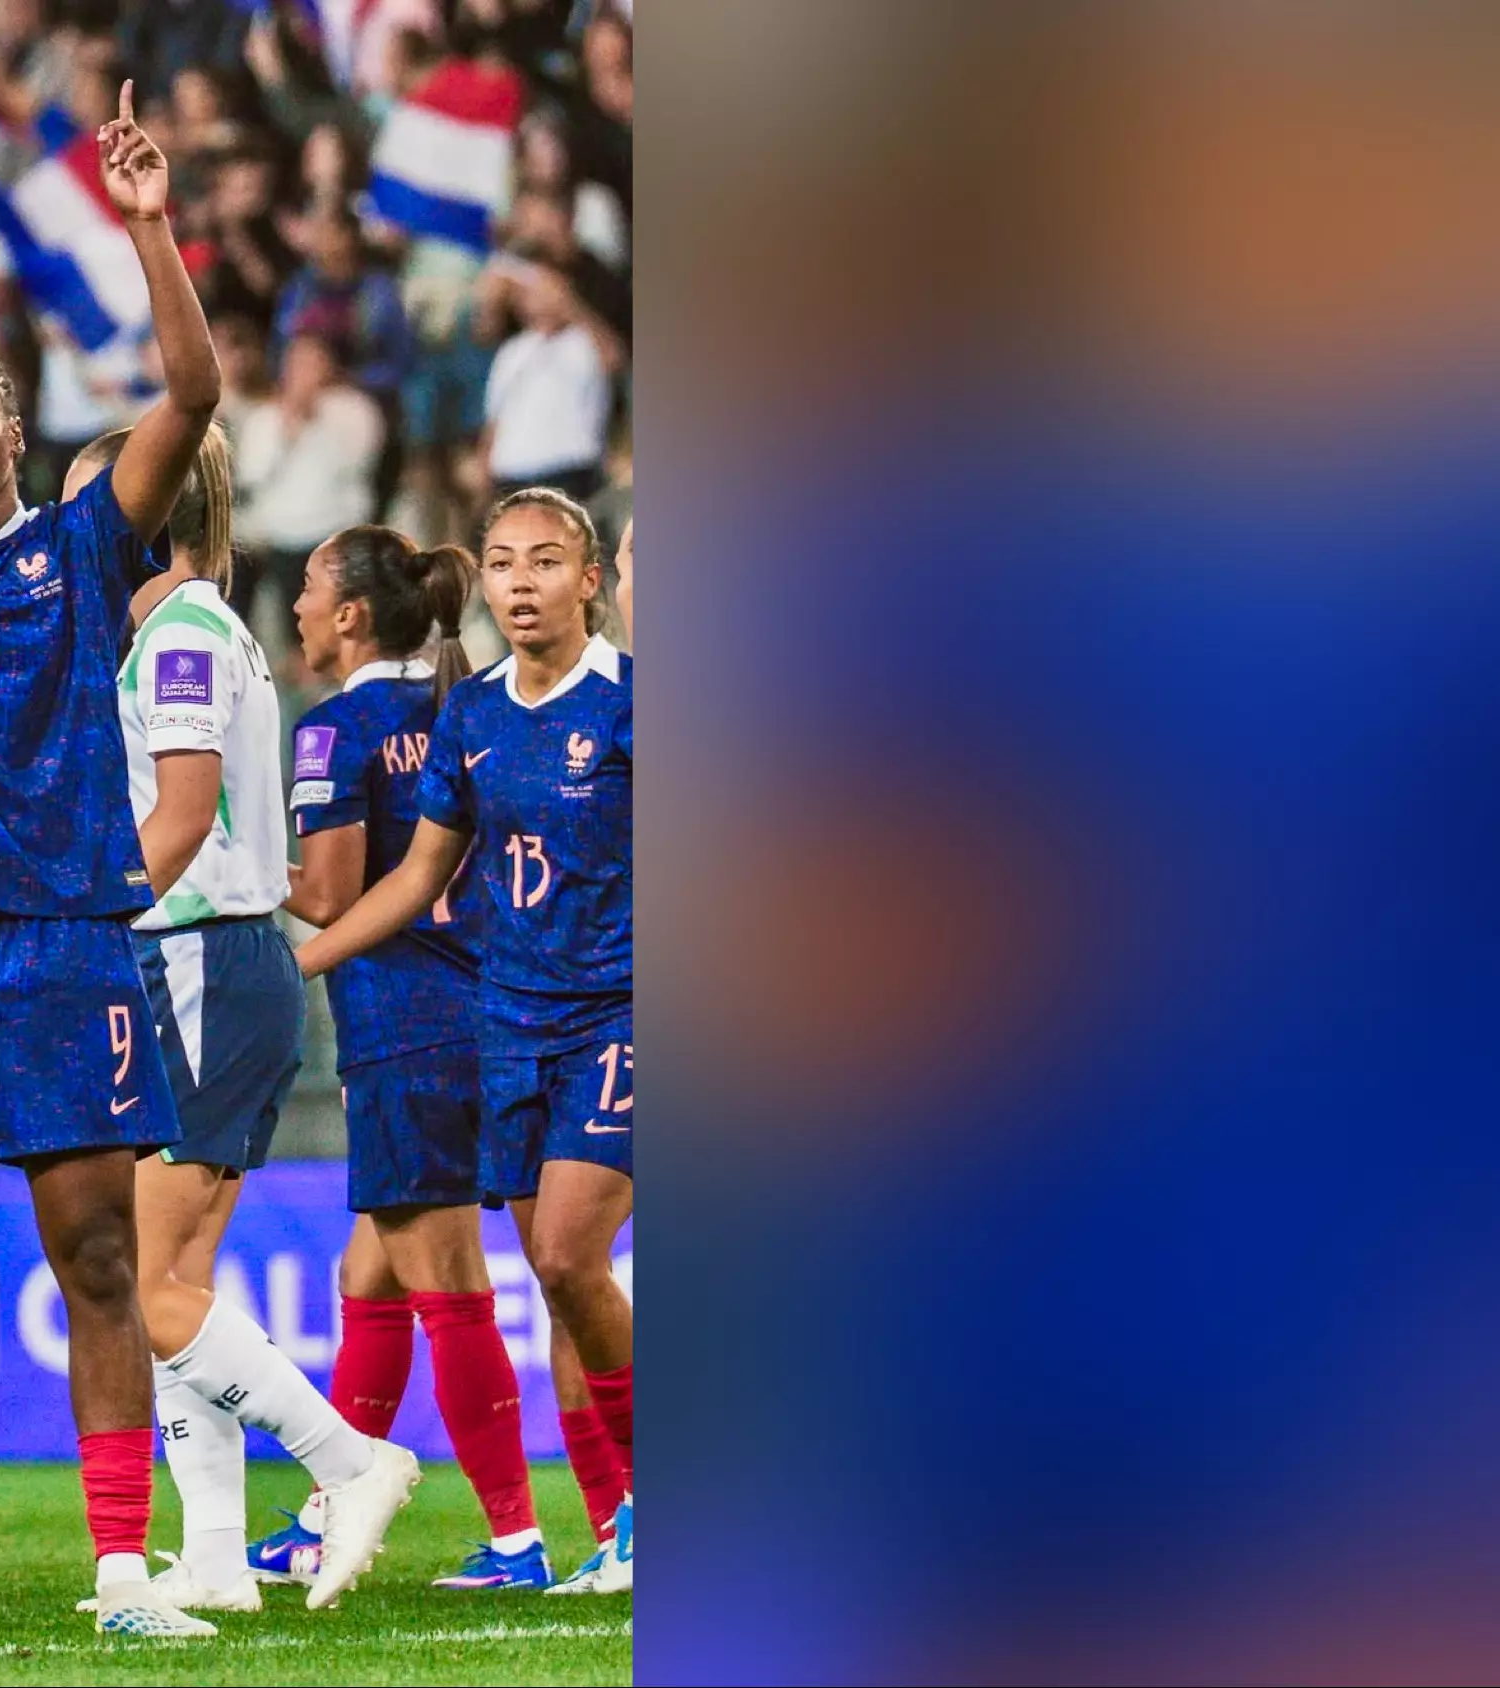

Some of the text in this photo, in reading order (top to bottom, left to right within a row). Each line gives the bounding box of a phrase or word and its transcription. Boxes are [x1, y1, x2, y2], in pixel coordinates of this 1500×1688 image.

[160, 690, 207, 698] QUALIFIERS
[504, 834, 550, 908] 13
[108, 1005, 132, 1086] 9
